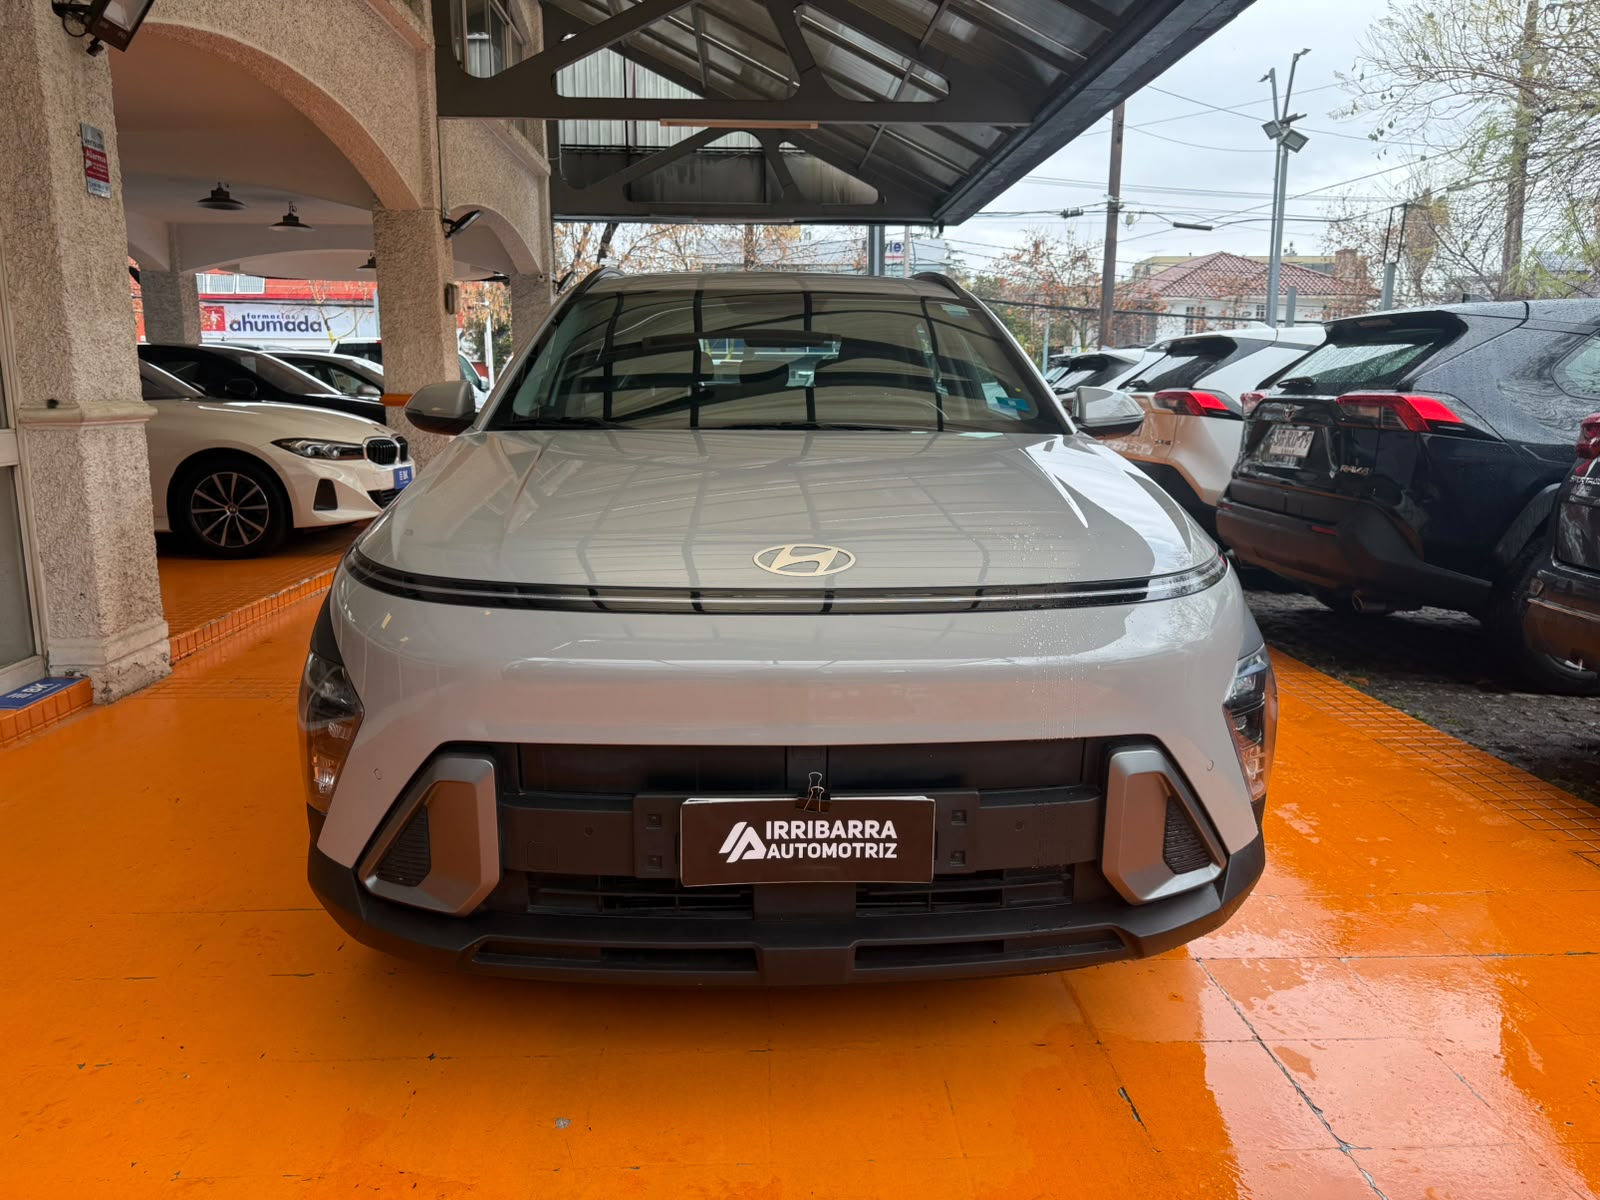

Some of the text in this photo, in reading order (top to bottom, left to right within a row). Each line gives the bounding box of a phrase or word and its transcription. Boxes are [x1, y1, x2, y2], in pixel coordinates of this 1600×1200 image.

[230, 314, 322, 332] ahumada
[246, 312, 299, 320] farmacias
[766, 820, 897, 839] IRRIBARRA
[767, 842, 897, 859] AUTOMOTRIZ
